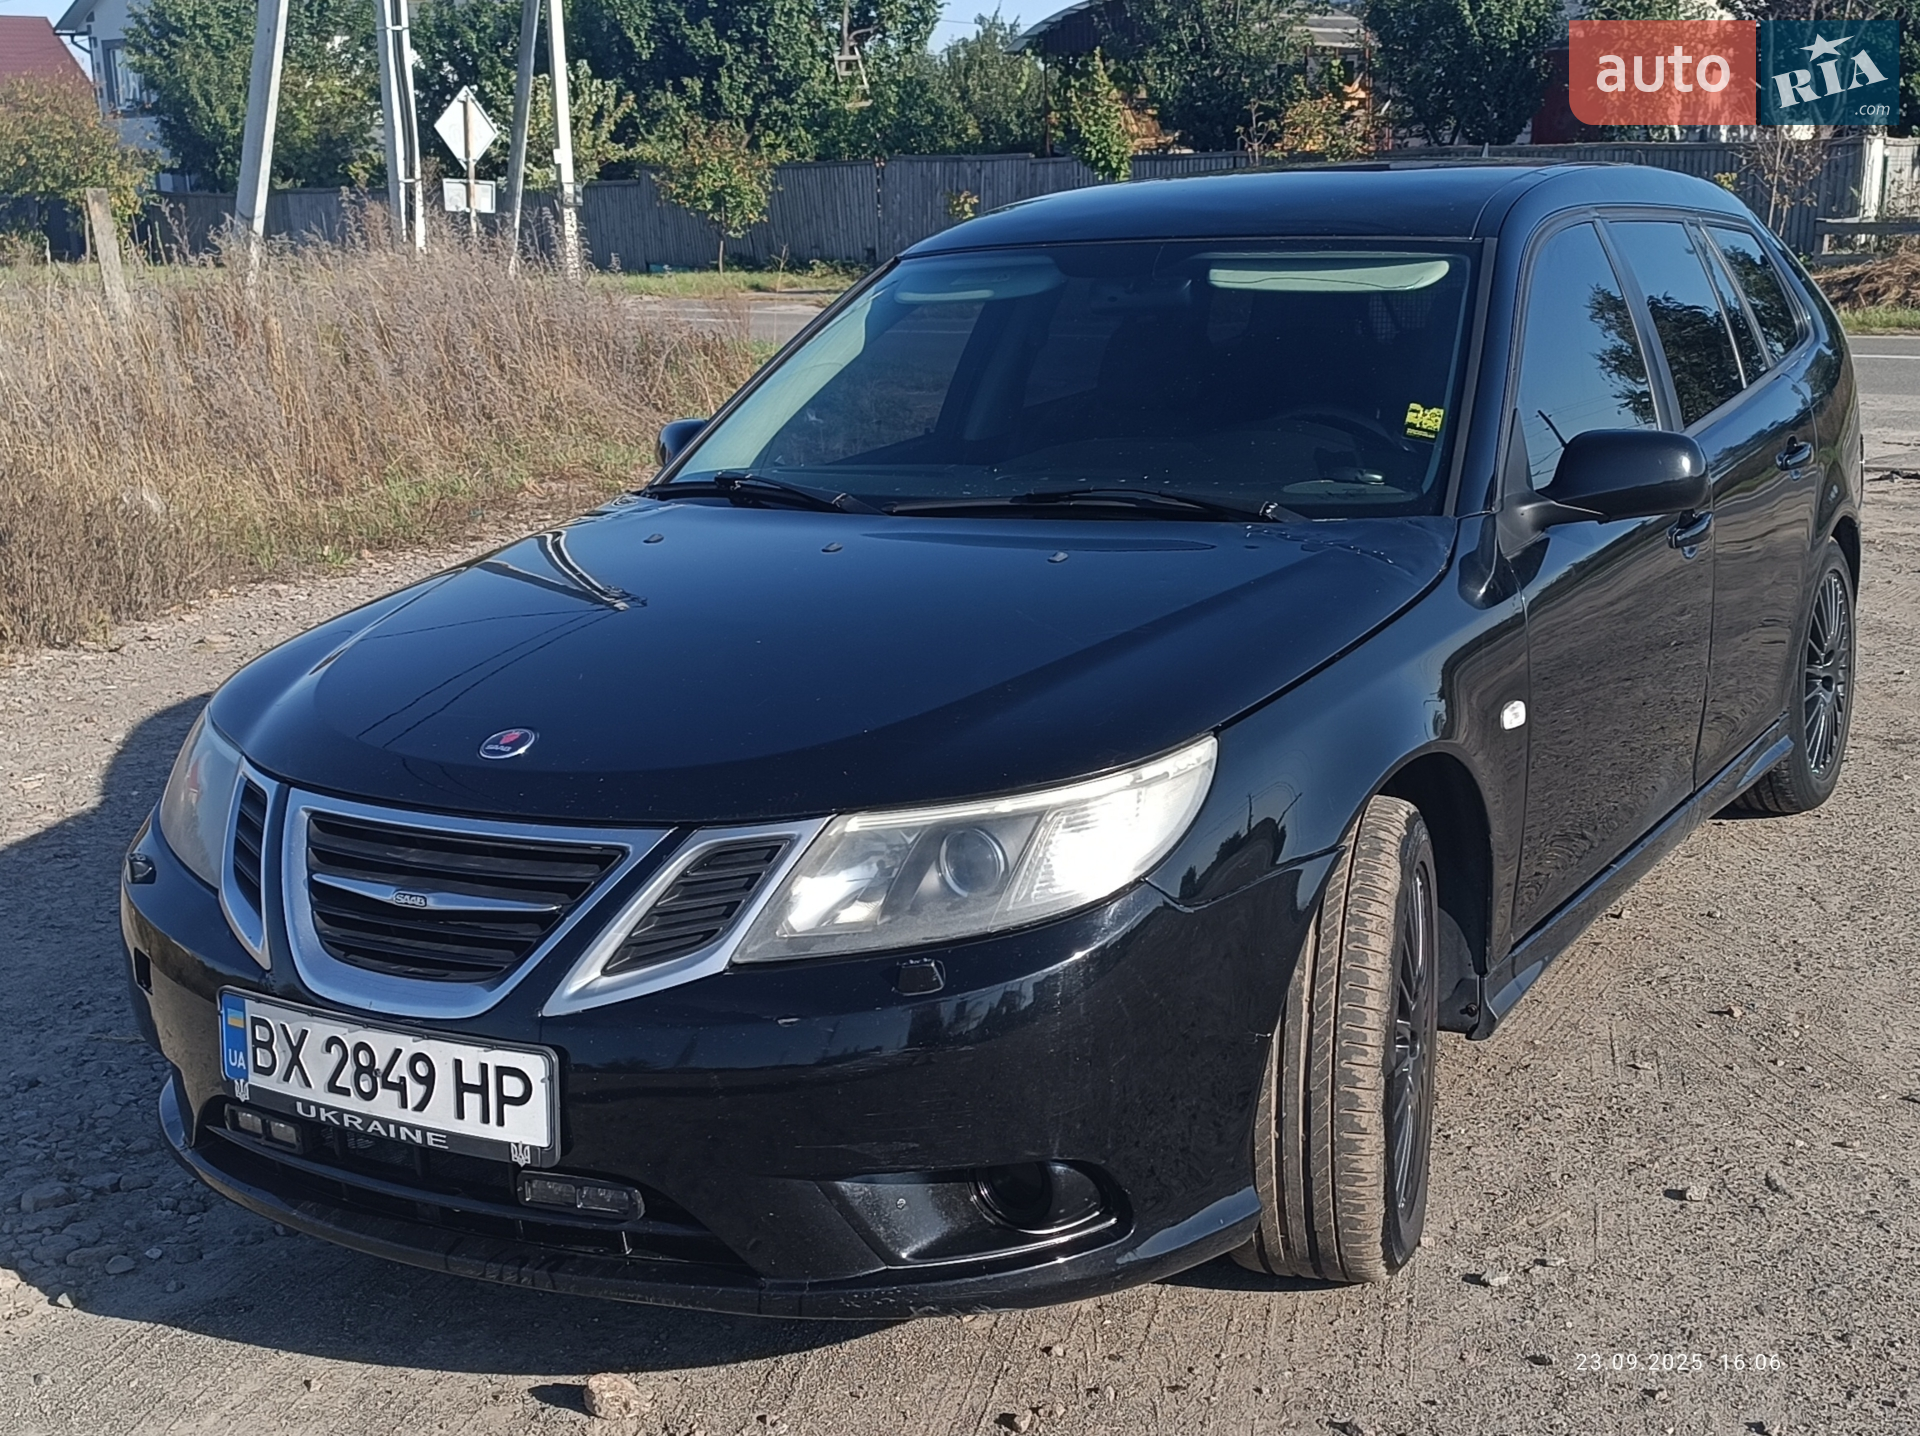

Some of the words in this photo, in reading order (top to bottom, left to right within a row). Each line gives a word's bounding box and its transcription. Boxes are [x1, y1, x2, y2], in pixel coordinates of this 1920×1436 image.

[485, 744, 513, 752] SAAB
[395, 893, 426, 907] SAAB
[228, 1048, 247, 1070] UA
[251, 1015, 313, 1088] BX
[325, 1035, 437, 1111] 2849
[454, 1058, 533, 1128] HP
[296, 1101, 449, 1150] UKRAINE
